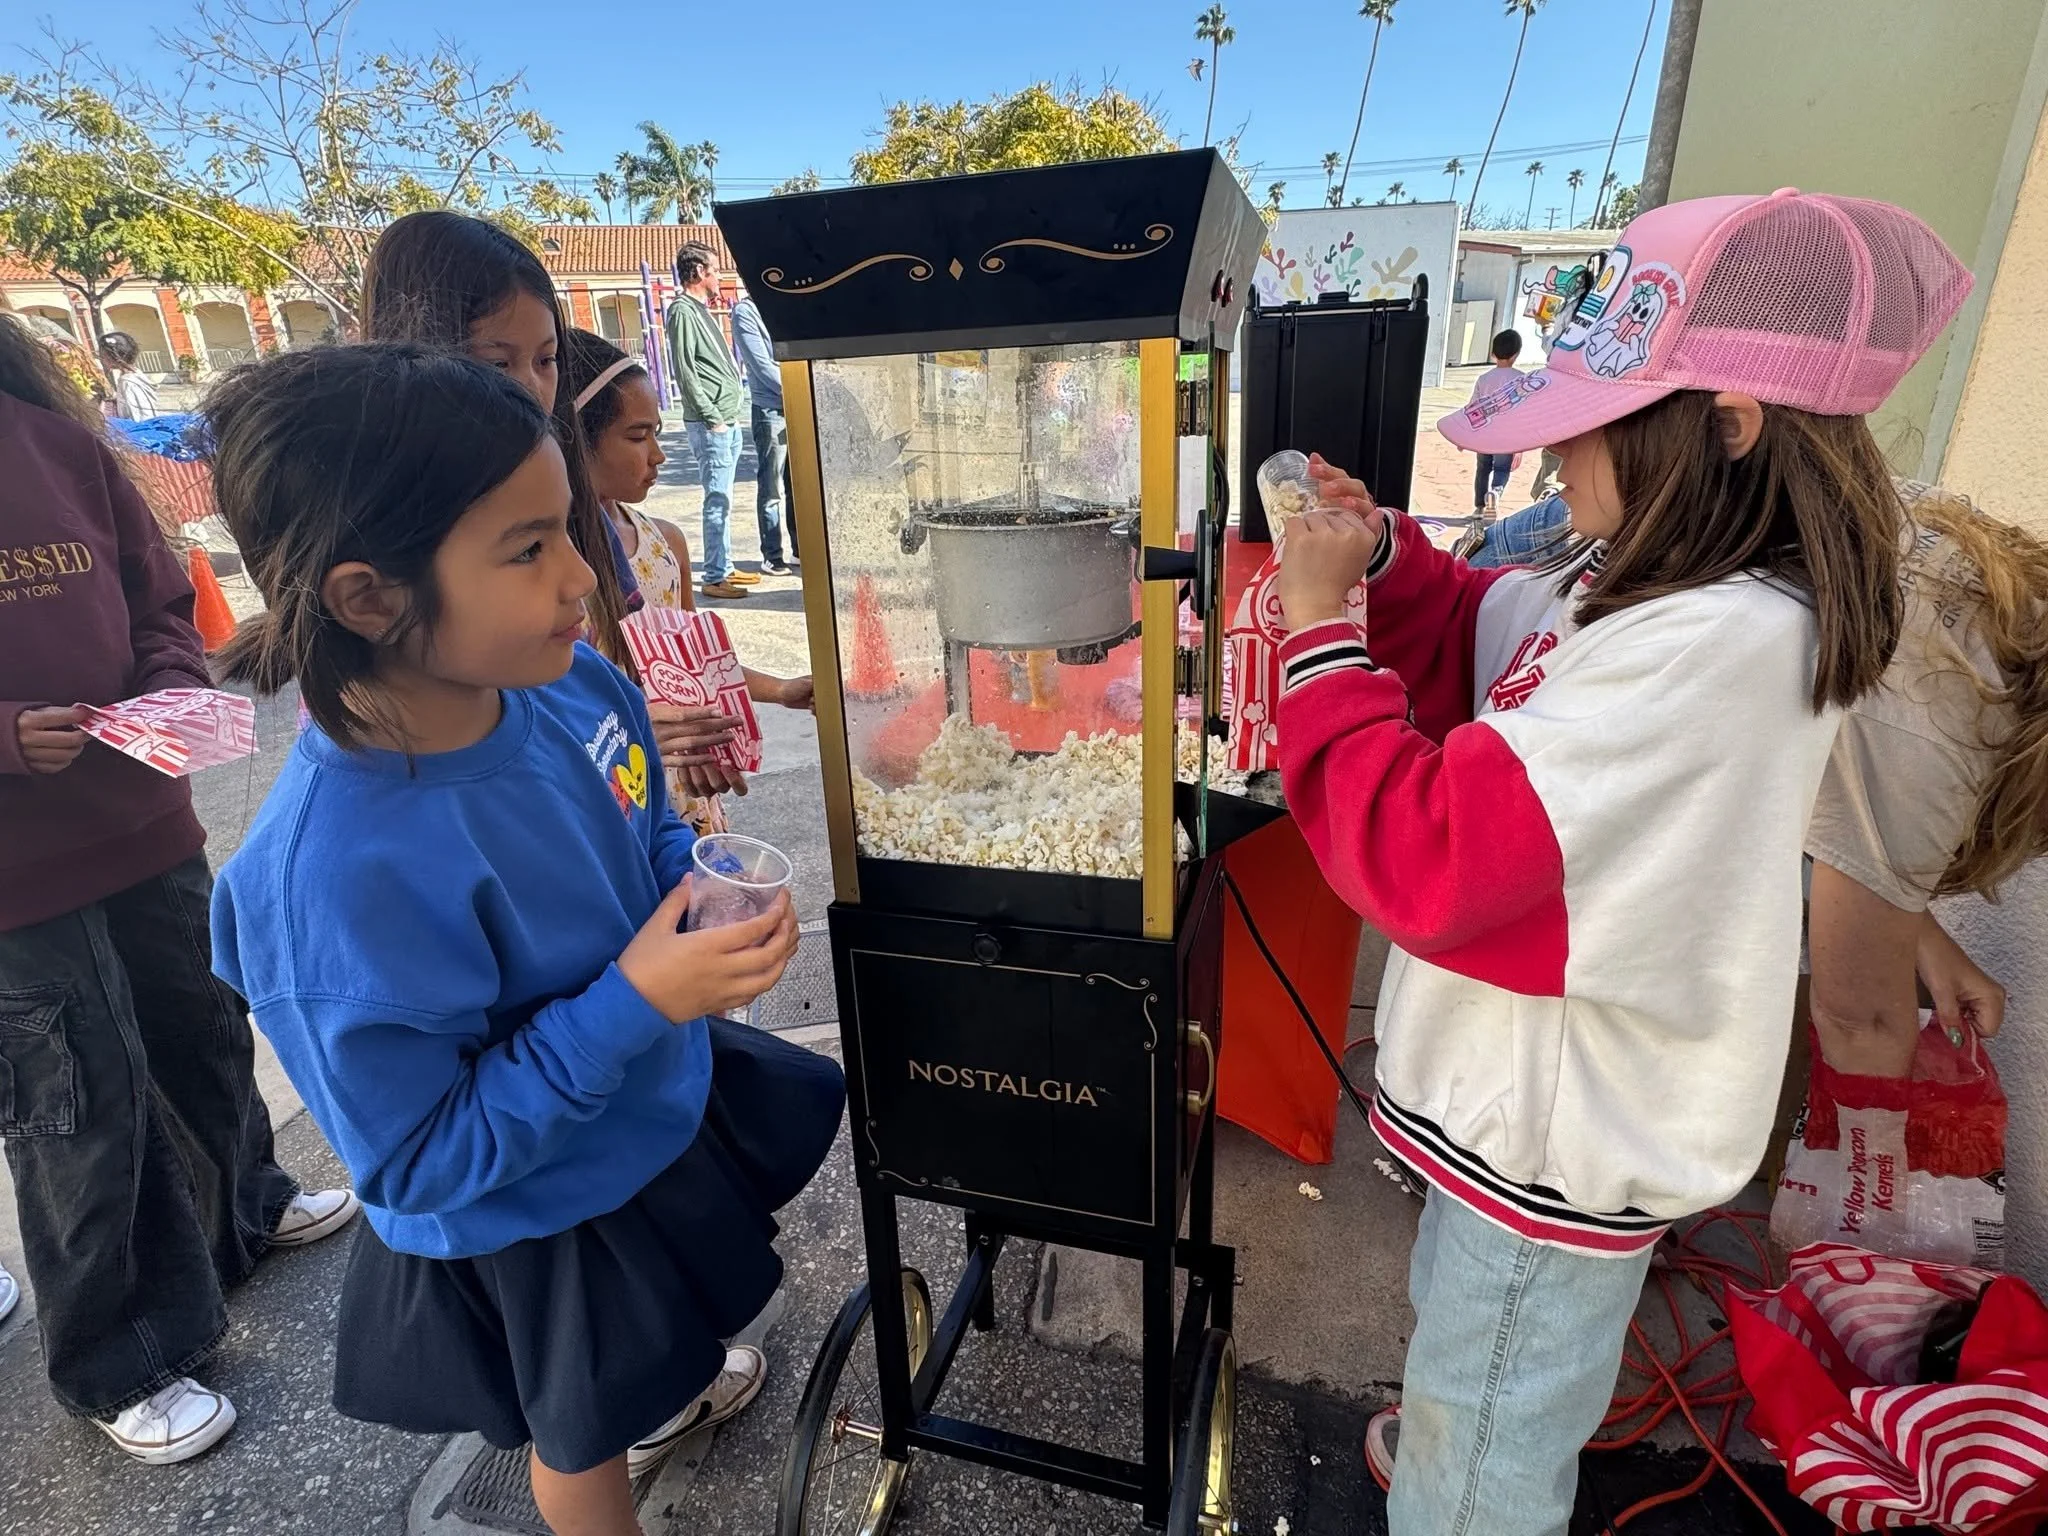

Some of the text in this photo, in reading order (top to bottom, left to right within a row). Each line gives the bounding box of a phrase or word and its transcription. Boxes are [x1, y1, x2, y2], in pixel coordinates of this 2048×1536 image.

[22, 583, 63, 599] YORK
[657, 669, 684, 683] POP
[658, 679, 698, 698] CORN
[1839, 1173, 1866, 1234] Yellow
